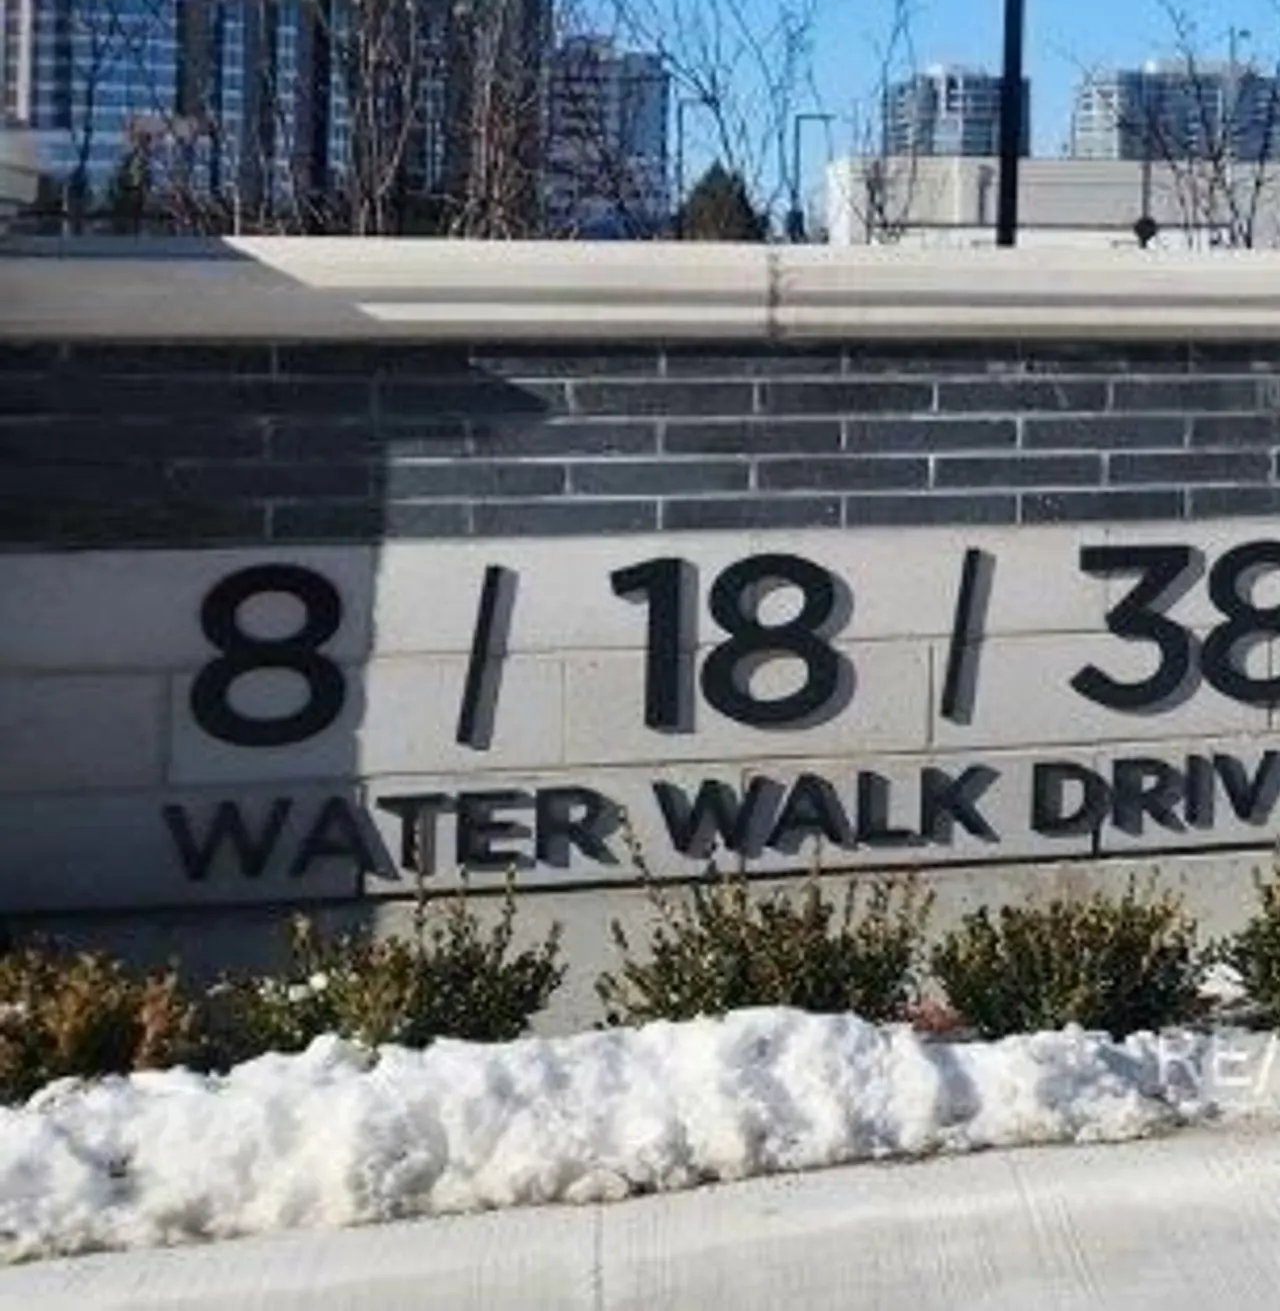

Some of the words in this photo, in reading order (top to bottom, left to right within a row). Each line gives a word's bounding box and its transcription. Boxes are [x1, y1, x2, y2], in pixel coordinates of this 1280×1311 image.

[189, 563, 346, 749] 8
[456, 565, 517, 751] /
[609, 553, 855, 734] 18
[941, 548, 996, 725] /
[162, 784, 622, 884] WATER
[653, 763, 1000, 861] WALK
